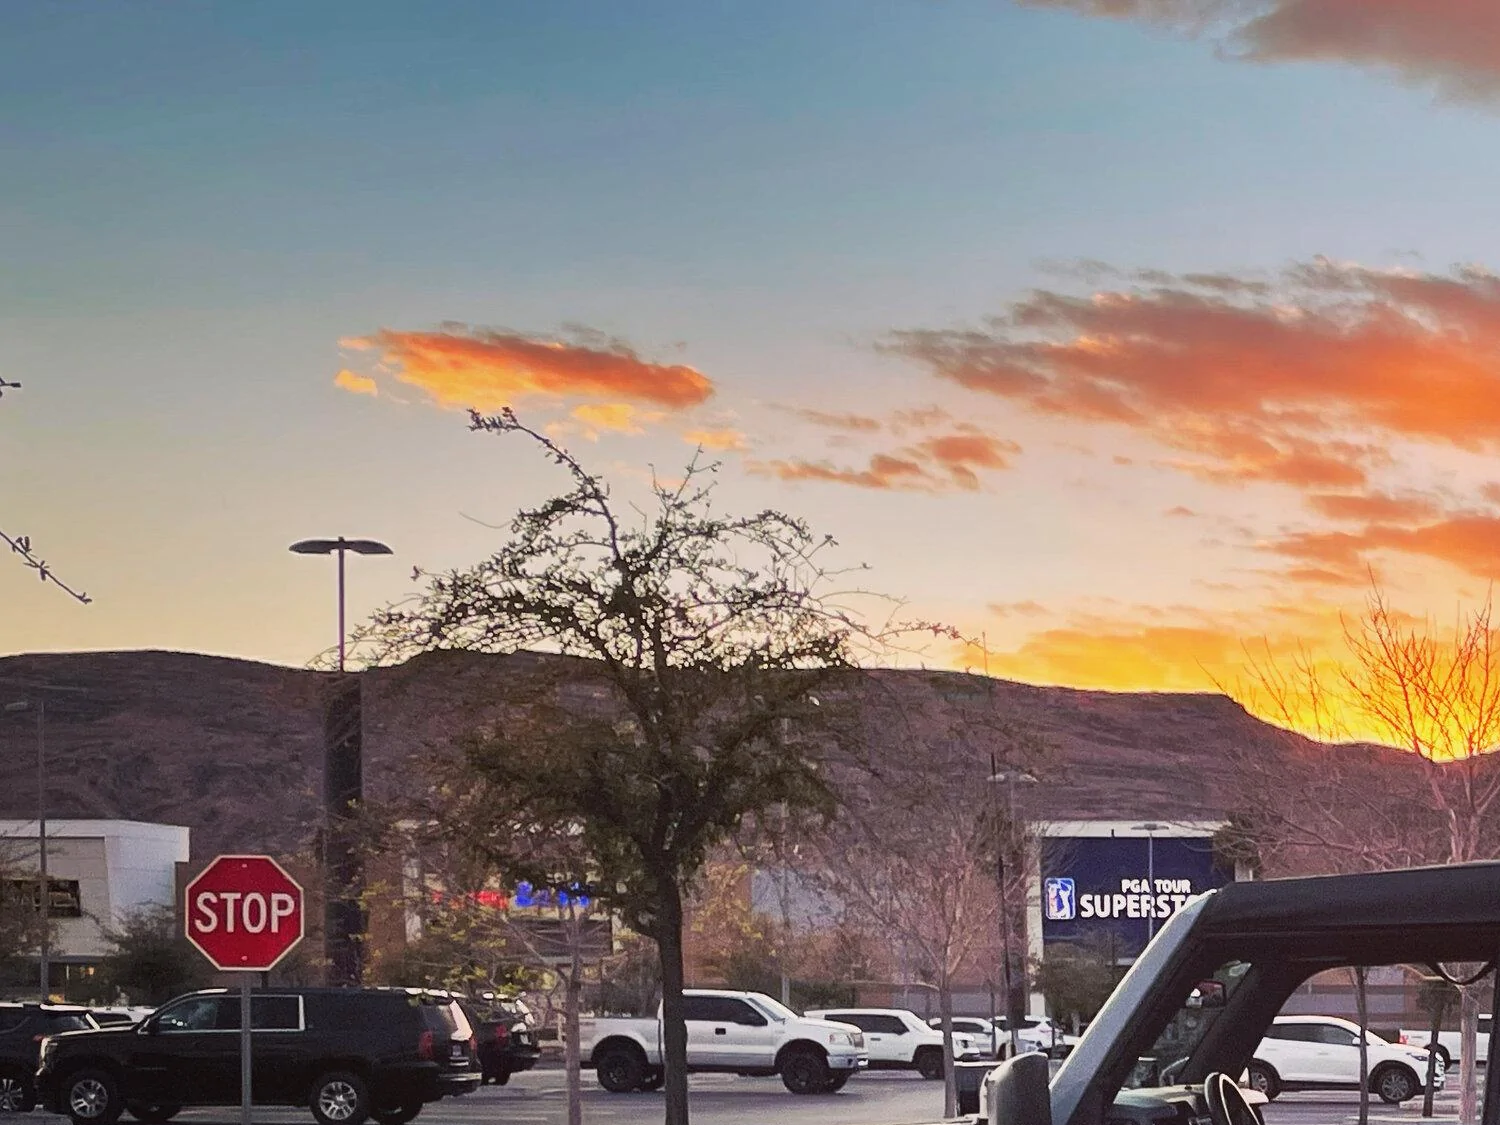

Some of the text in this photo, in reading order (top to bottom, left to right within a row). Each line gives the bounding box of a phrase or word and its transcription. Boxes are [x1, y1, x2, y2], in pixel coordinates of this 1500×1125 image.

[1121, 879, 1191, 893] PGA TOUR
[194, 891, 295, 934] STOP
